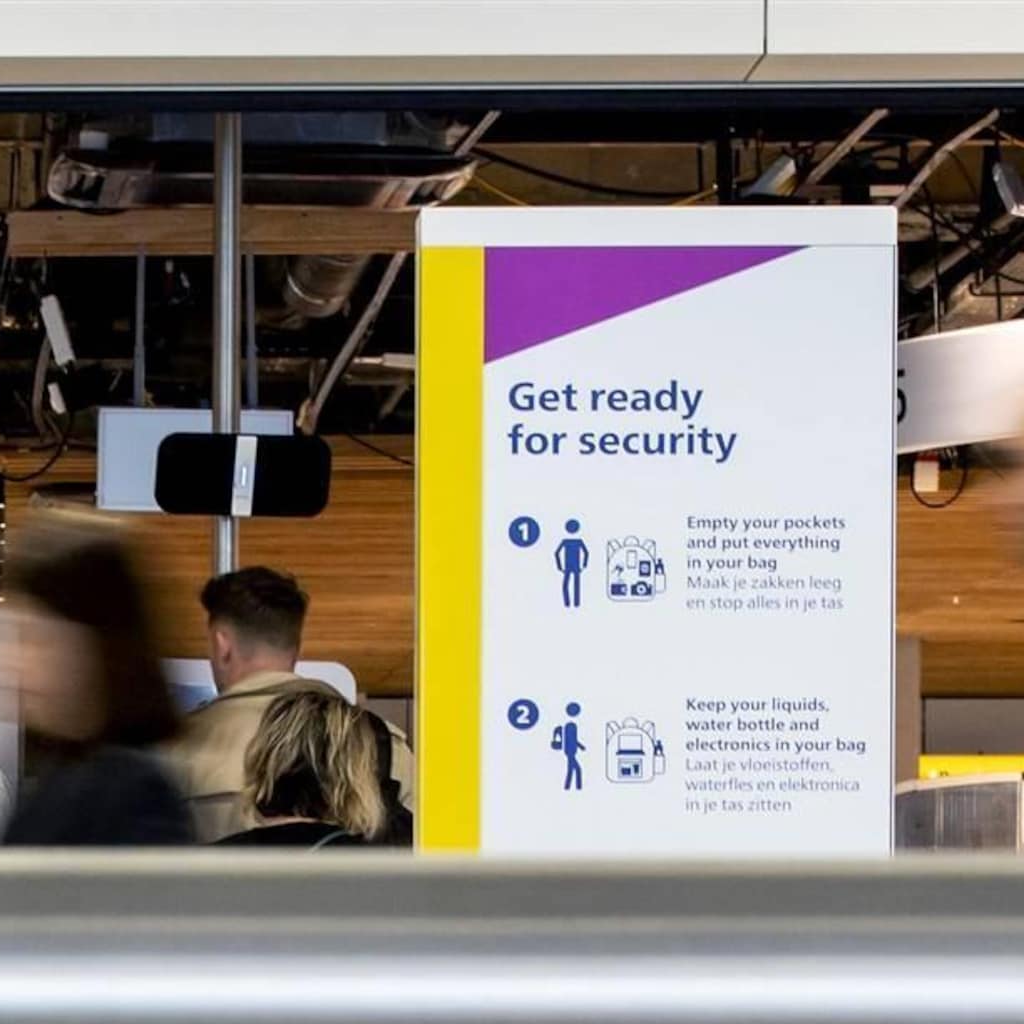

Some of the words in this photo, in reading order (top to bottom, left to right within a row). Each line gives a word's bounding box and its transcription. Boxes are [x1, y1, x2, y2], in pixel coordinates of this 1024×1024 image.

[507, 382, 579, 413] Get
[590, 379, 705, 422] ready
[506, 423, 569, 456] for
[578, 424, 739, 465] security
[686, 516, 739, 533] Empty
[742, 518, 781, 534] your
[783, 515, 846, 533] pockets
[686, 536, 718, 550] and
[721, 537, 750, 553] put
[752, 536, 841, 554] everything
[686, 556, 702, 570] in
[705, 558, 745, 574] your
[747, 554, 778, 574] bag
[686, 576, 730, 590] Maak
[733, 575, 747, 593] je
[751, 576, 806, 590] zakken
[808, 576, 842, 594] leeg
[685, 599, 706, 610] en
[709, 597, 744, 613] stop
[746, 595, 781, 609] alles
[785, 597, 800, 609] in
[803, 599, 817, 613] je
[820, 597, 844, 610] tas
[685, 698, 727, 715] Keep
[730, 701, 768, 716] your
[771, 697, 830, 715] liquids,
[684, 719, 733, 732] water
[736, 717, 786, 732] bottle
[788, 718, 820, 732] and
[685, 737, 771, 753] electronics
[775, 738, 791, 752] in
[793, 741, 833, 756] your
[835, 737, 867, 756] bag
[685, 758, 718, 772] Laat
[722, 761, 737, 775] je
[739, 757, 833, 773] vloeistoffen,
[684, 778, 754, 792] waterfles
[756, 781, 776, 793] en
[778, 778, 860, 793] elektronica
[685, 798, 701, 812] in
[703, 800, 718, 815] je
[721, 800, 744, 812] tas
[747, 800, 792, 812] zitten
